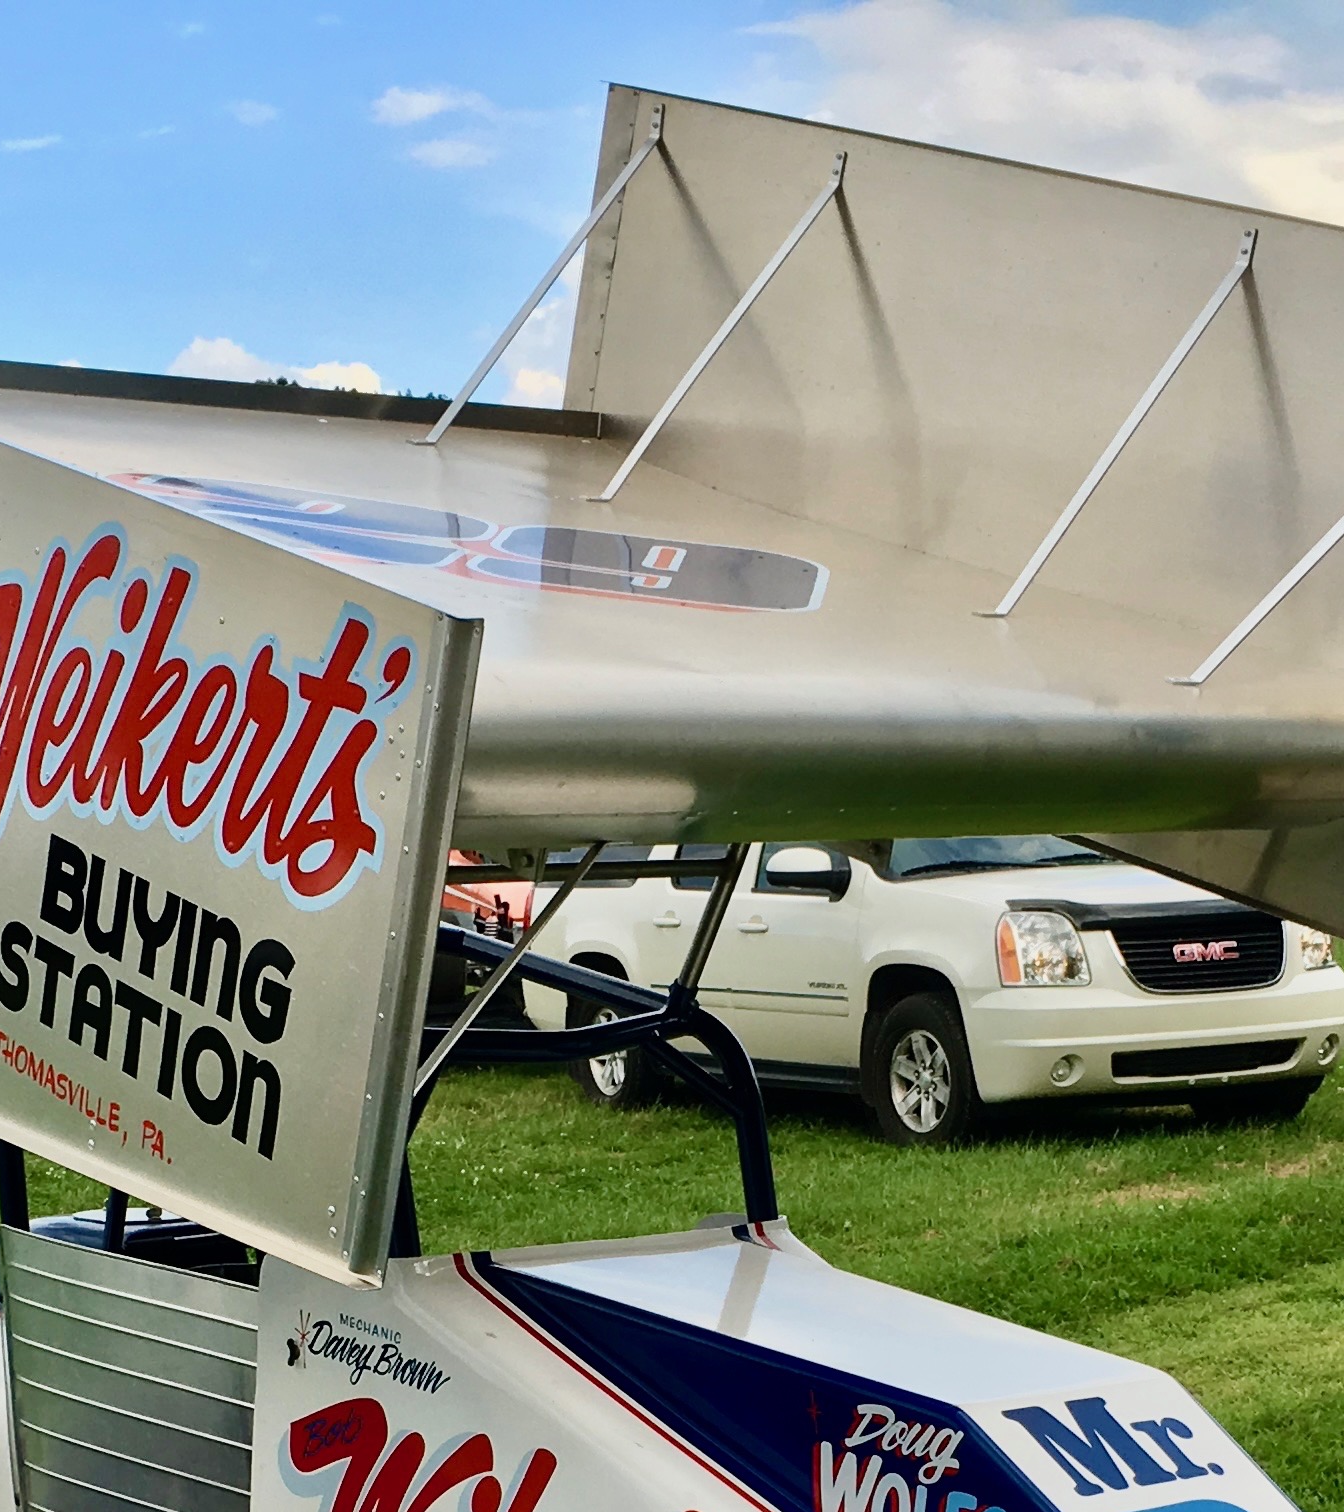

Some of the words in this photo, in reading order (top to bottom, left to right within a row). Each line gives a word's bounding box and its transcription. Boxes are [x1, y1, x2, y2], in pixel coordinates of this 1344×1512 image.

[40, 834, 296, 1044] BUYING
[1173, 940, 1240, 962] GMC
[142, 1119, 173, 1166] PA.
[308, 1320, 376, 1385] Davey
[373, 1343, 451, 1394] Brown
[339, 1313, 403, 1344] MECHANIC
[845, 1403, 965, 1485] Doug
[1001, 1396, 1225, 1497] Mr.
